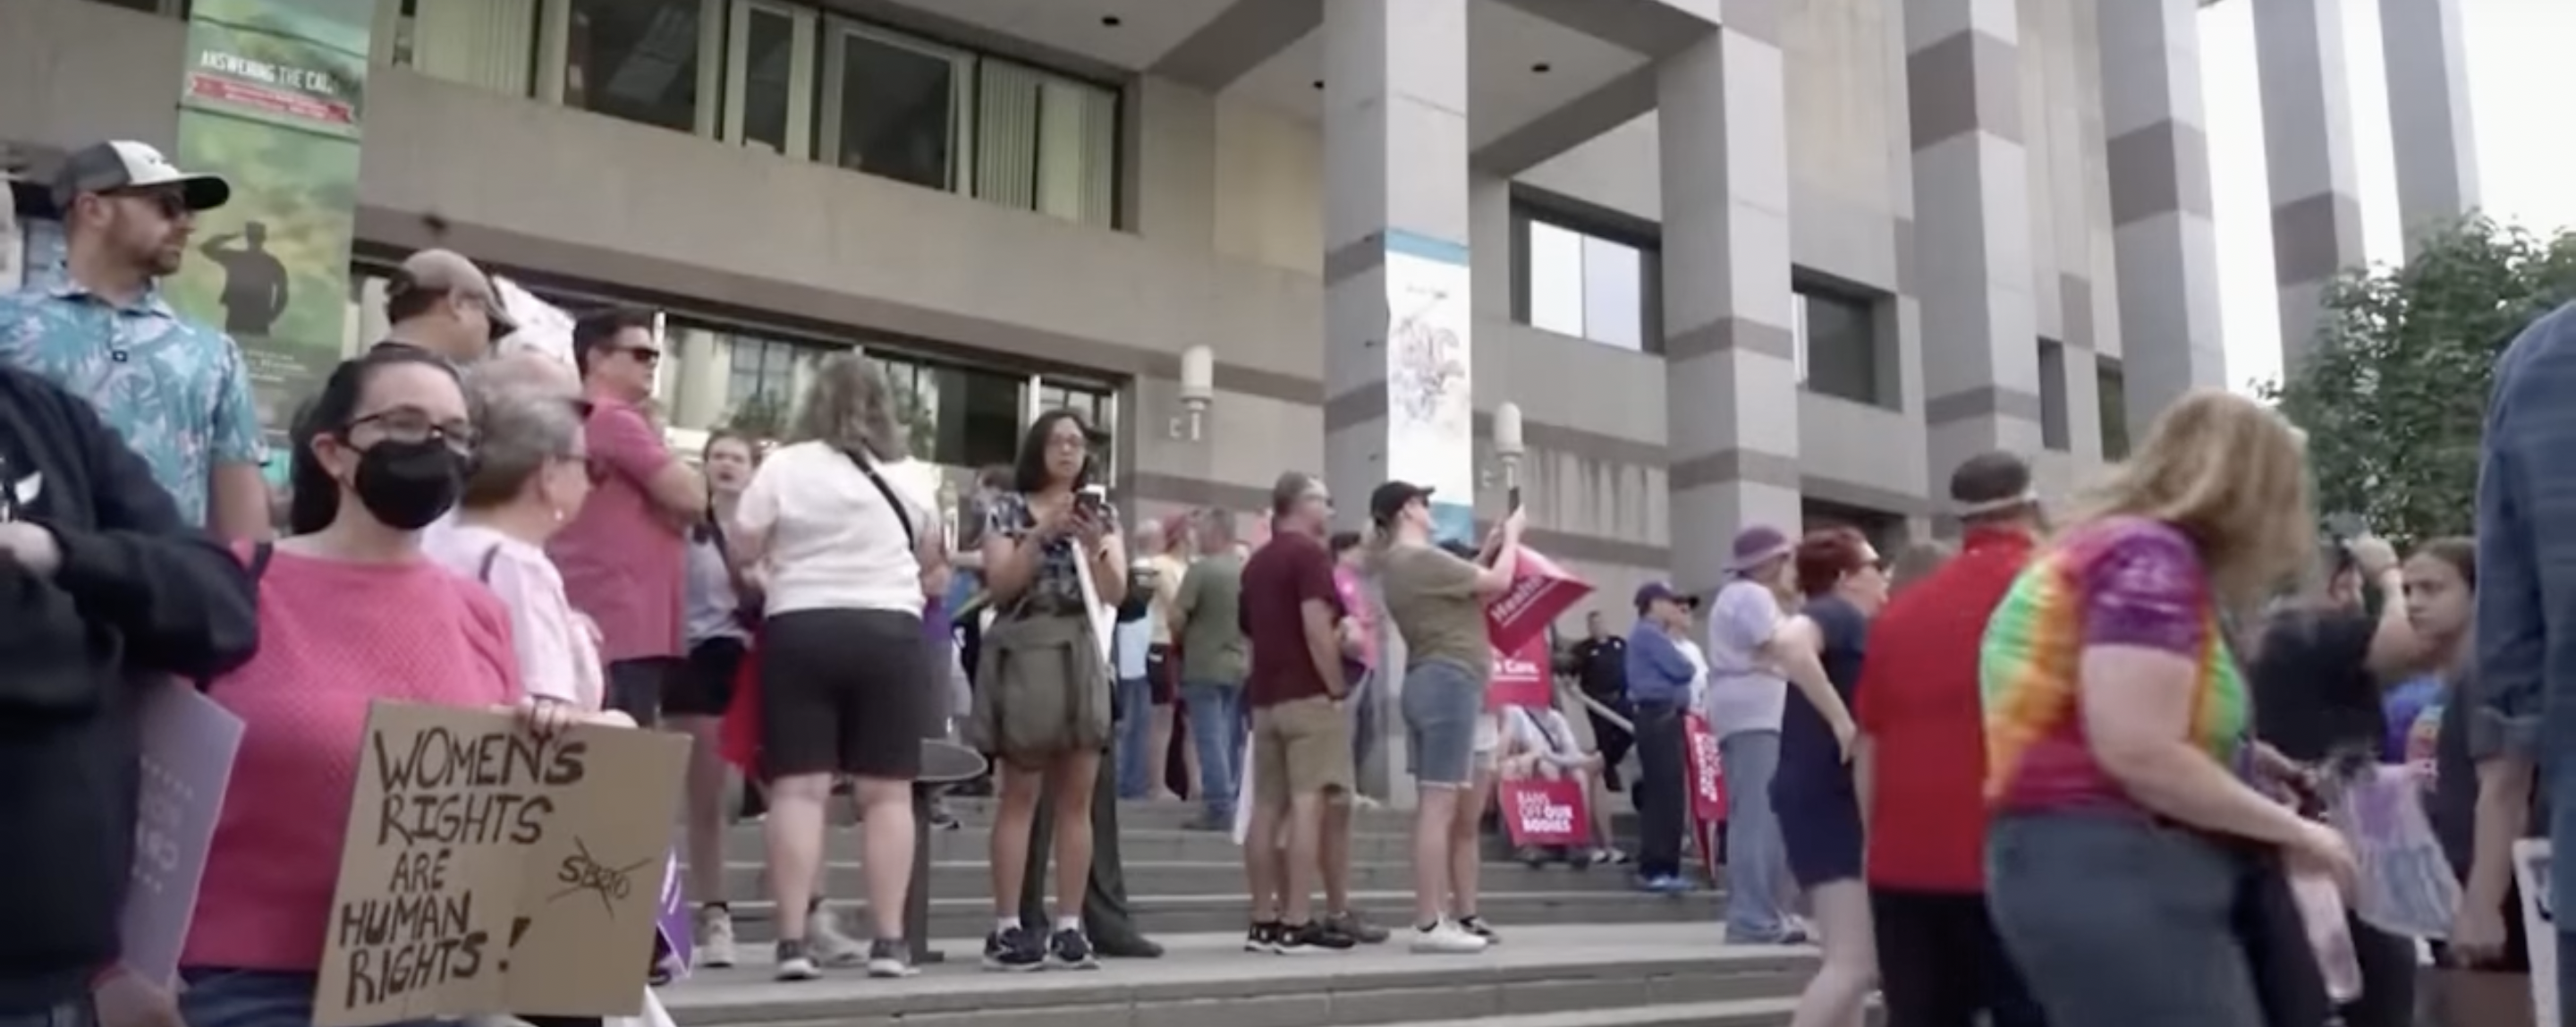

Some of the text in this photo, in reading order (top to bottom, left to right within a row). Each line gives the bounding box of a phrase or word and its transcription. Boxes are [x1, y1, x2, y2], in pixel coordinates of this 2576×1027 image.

[278, 65, 302, 88] THE
[377, 794, 555, 846] RIGHTS
[388, 848, 452, 893] ARE
[339, 890, 472, 949] HUMAN
